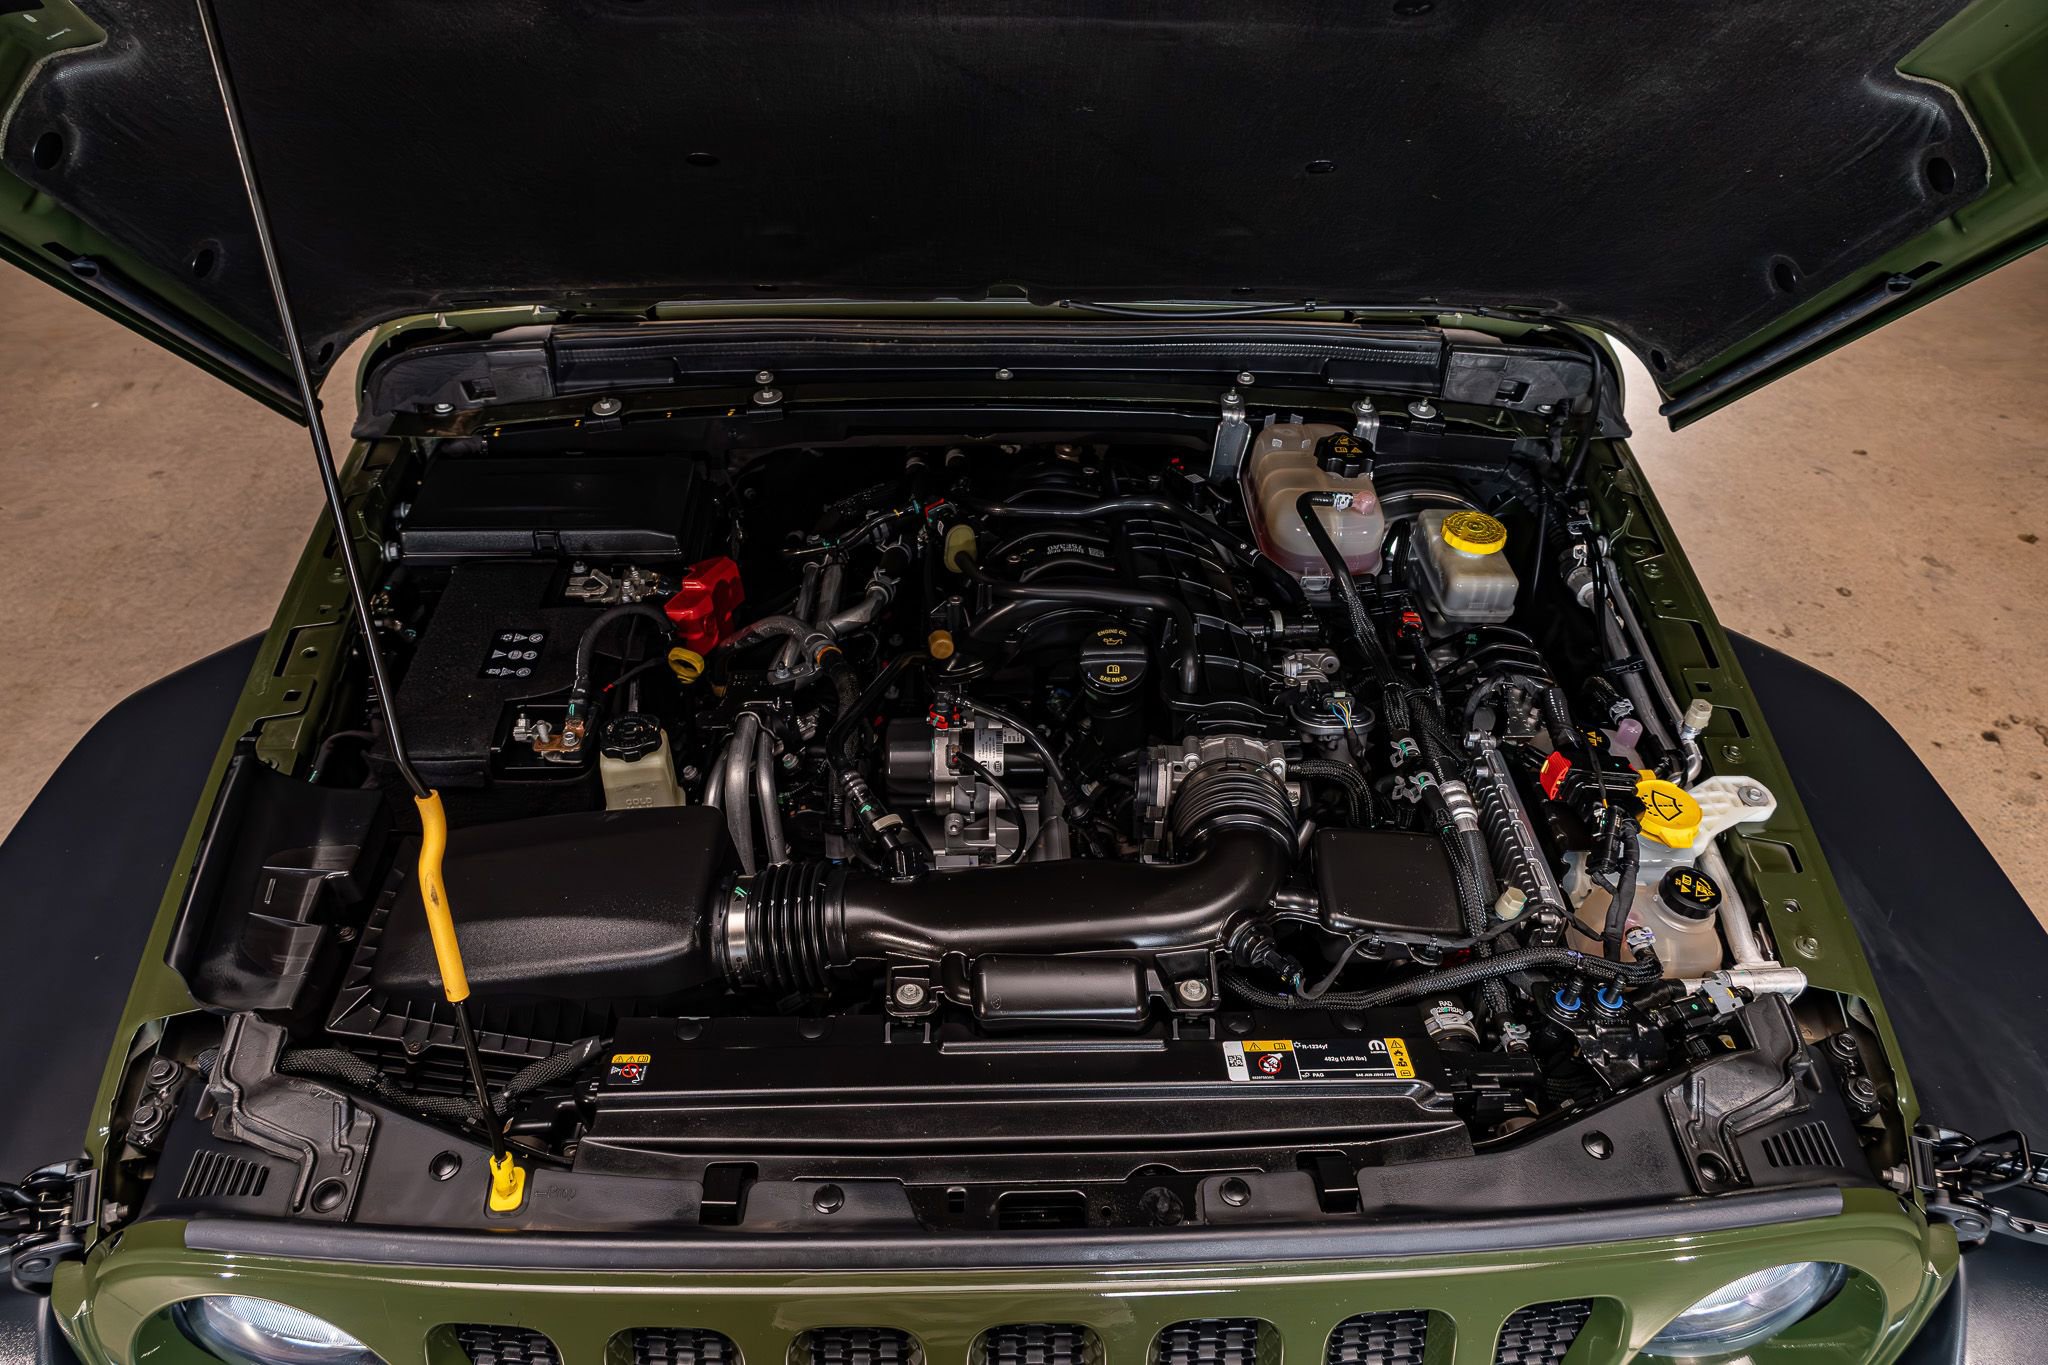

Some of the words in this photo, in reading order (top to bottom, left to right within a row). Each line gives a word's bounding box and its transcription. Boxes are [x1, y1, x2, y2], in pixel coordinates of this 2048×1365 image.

[1097, 628, 1118, 637] ENGINE
[1118, 629, 1128, 637] OIL
[1099, 675, 1111, 683] SAE
[1111, 675, 1128, 683] 0W-20
[626, 797, 652, 805] COLD
